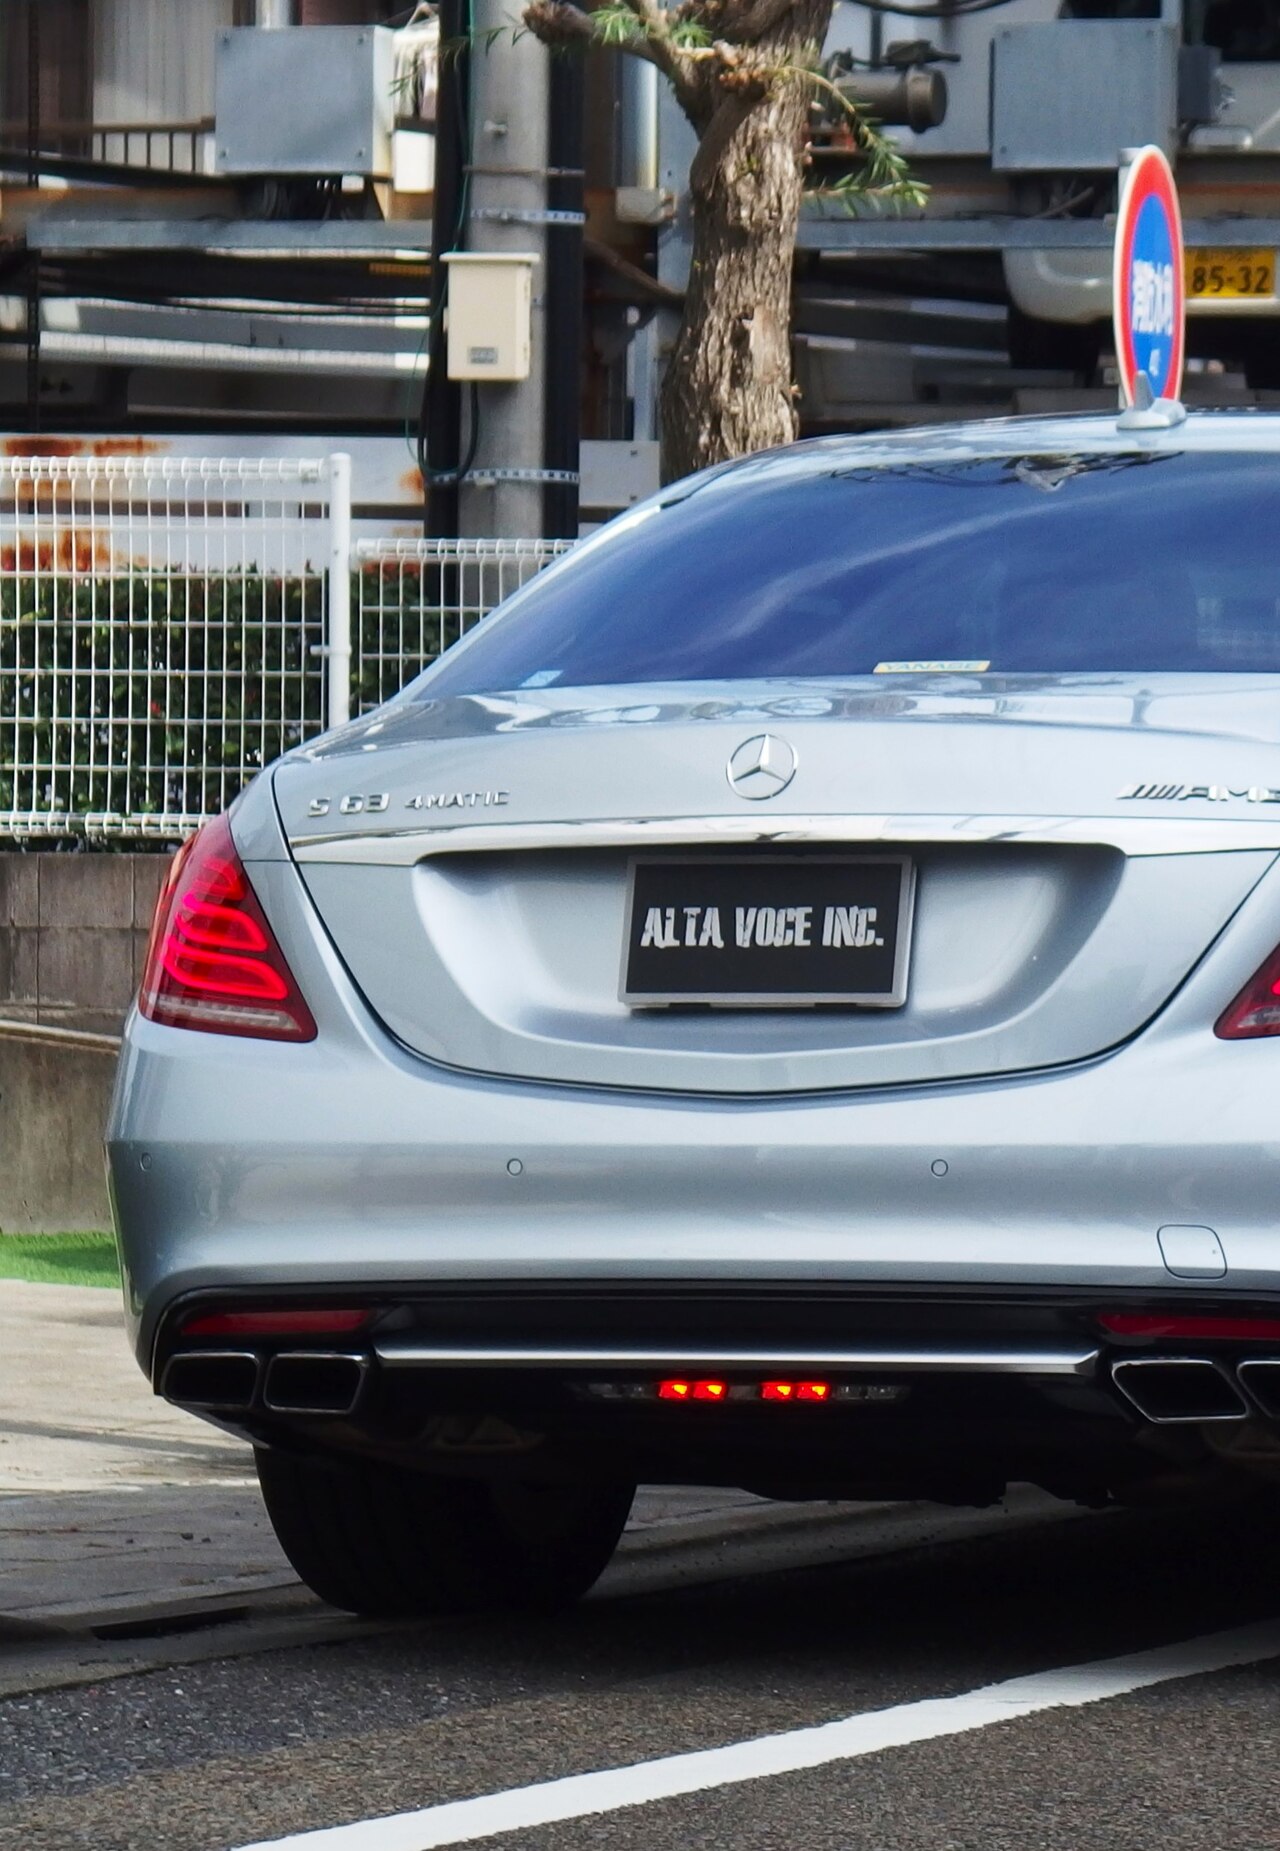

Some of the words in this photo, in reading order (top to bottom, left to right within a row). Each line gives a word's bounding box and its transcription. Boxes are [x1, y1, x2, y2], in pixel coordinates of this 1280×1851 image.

[1192, 265, 1270, 294] 85-32
[308, 796, 331, 817] S
[339, 792, 390, 814] 63
[405, 790, 510, 810] 4MATIC
[640, 906, 725, 949] ALTA
[735, 906, 813, 948] VOCE
[821, 905, 885, 948] INC.
